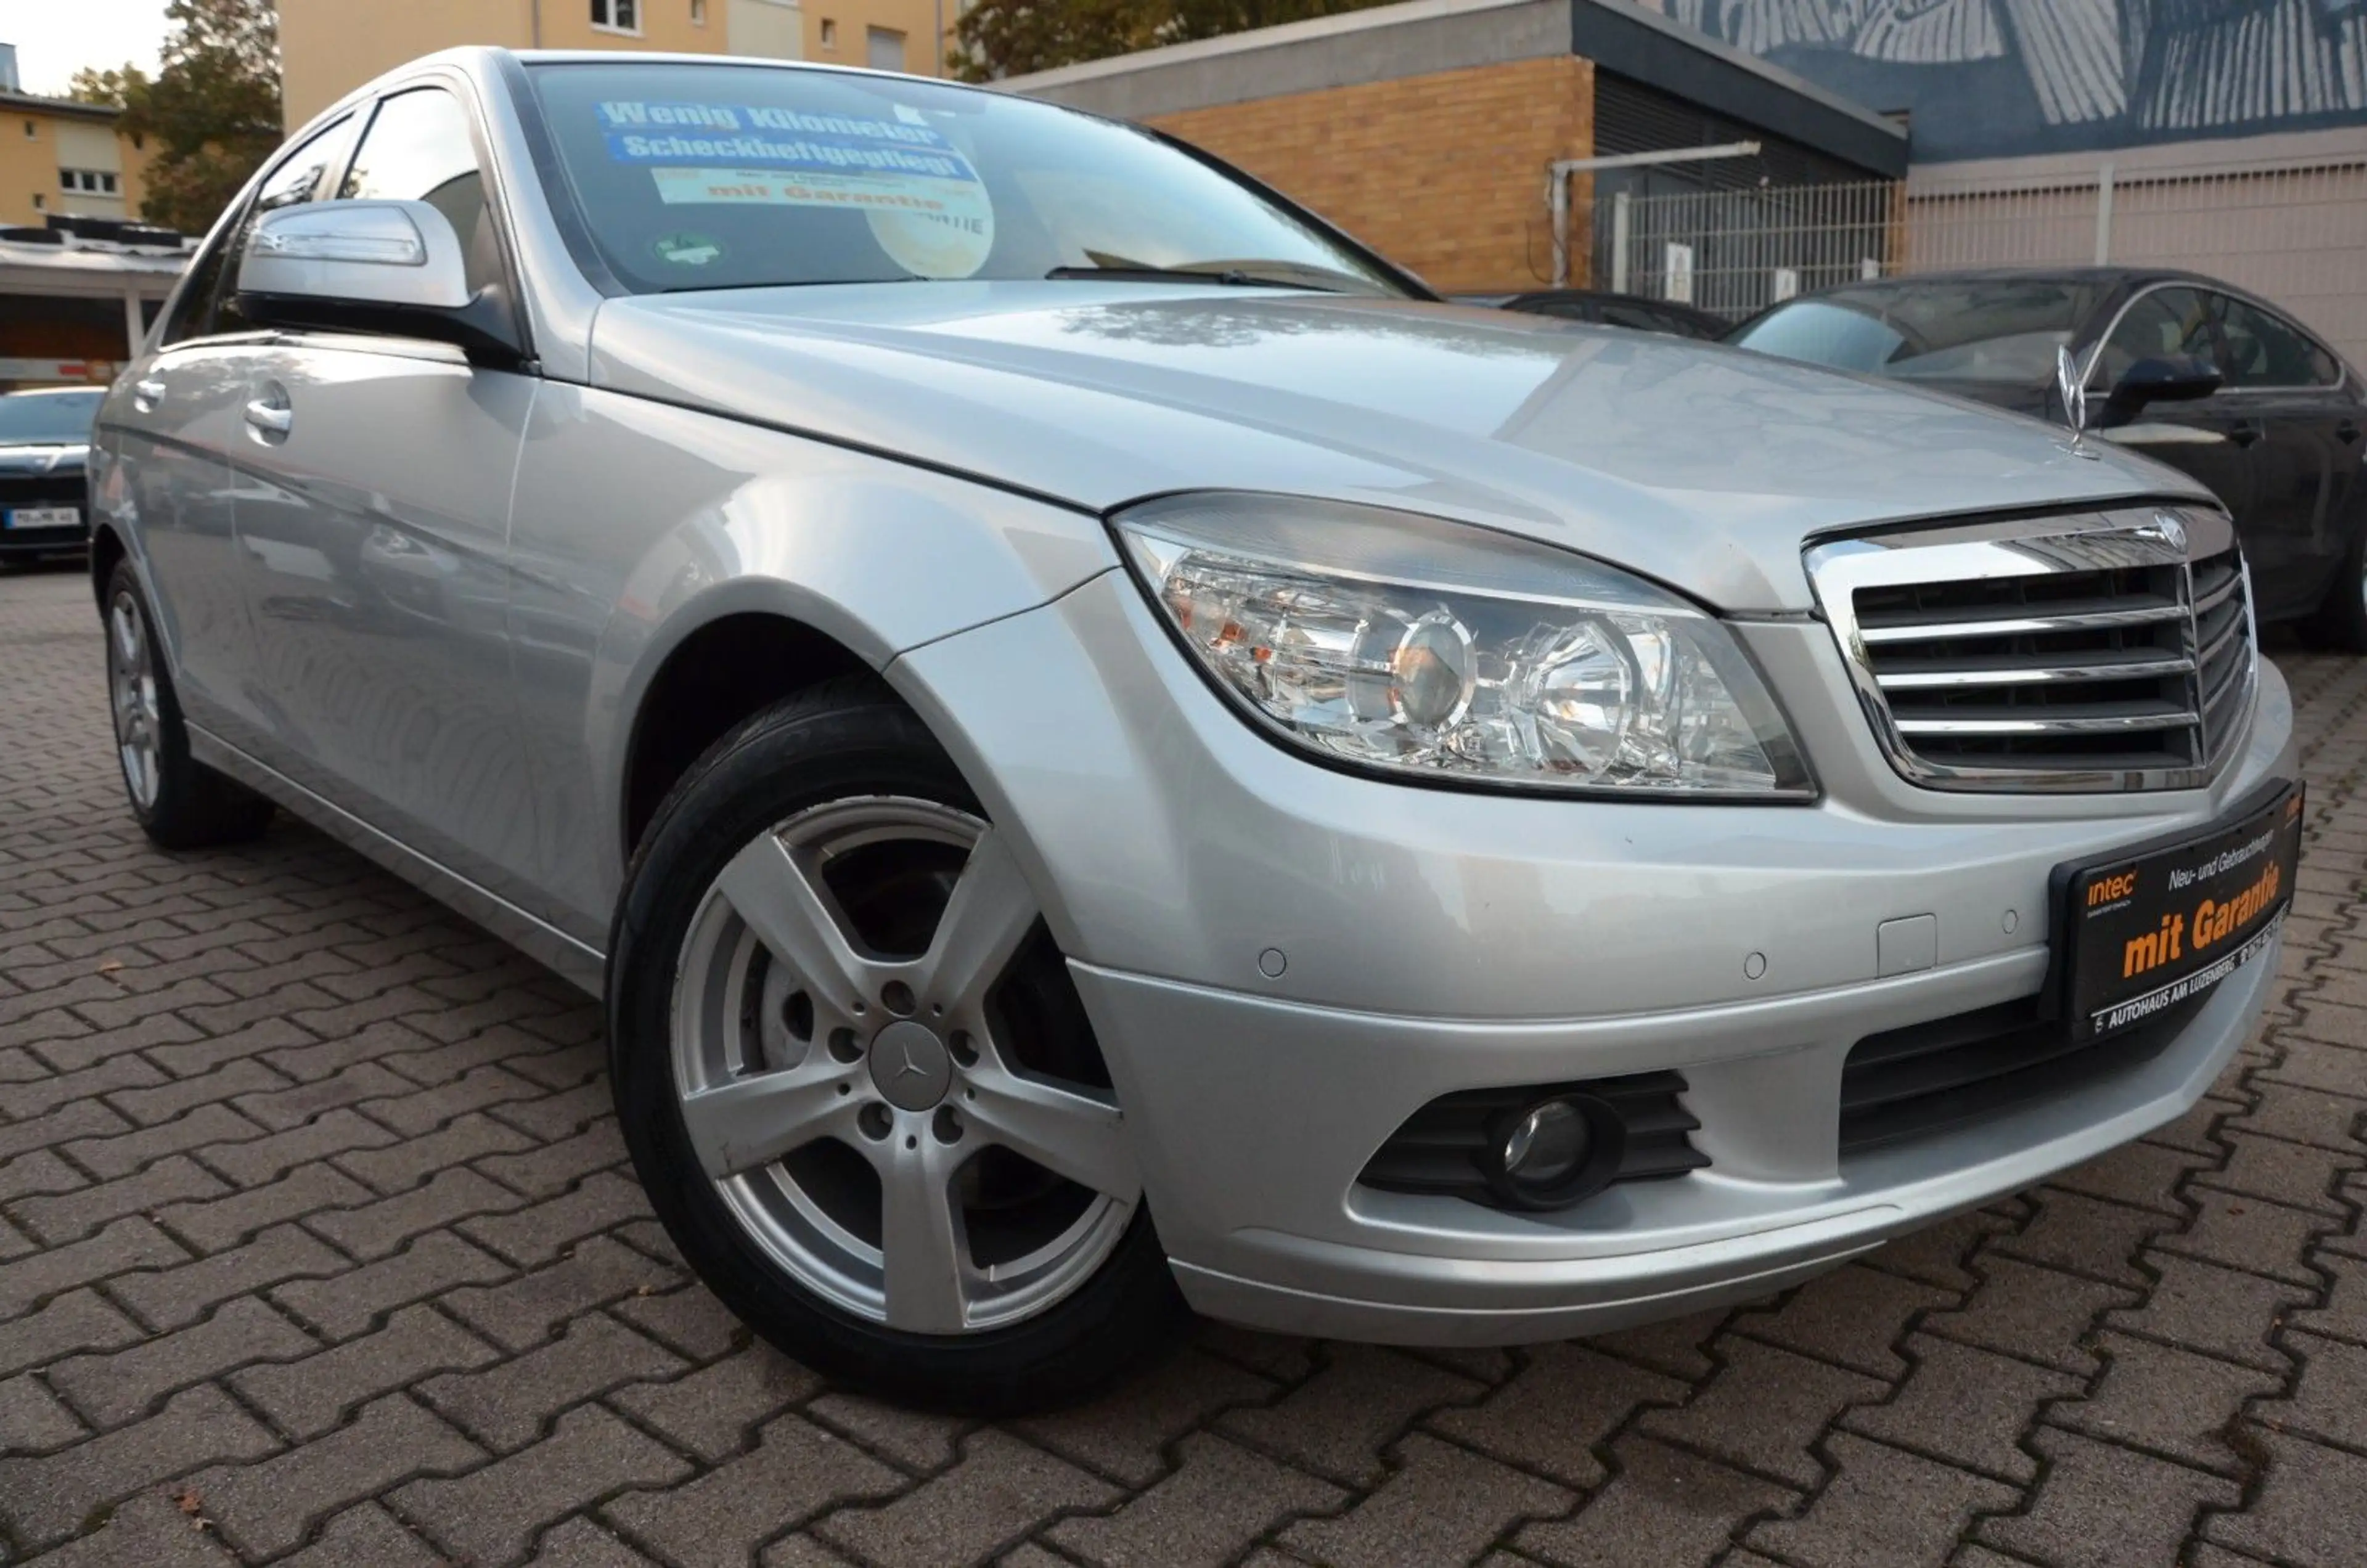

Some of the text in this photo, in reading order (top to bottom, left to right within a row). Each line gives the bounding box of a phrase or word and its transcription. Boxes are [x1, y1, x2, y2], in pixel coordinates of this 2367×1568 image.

[600, 101, 939, 145] Wenig Kilometer
[622, 135, 960, 176] Scheckheftgepflegt
[708, 184, 769, 197] mit
[783, 186, 944, 210] Garantie
[2168, 868, 2196, 892] Neu-
[2198, 855, 2218, 881] und
[2124, 913, 2183, 978] mit
[2192, 860, 2279, 949] Garantie
[2108, 991, 2169, 1029] AUTOHAUS
[2170, 982, 2188, 1004] AM
